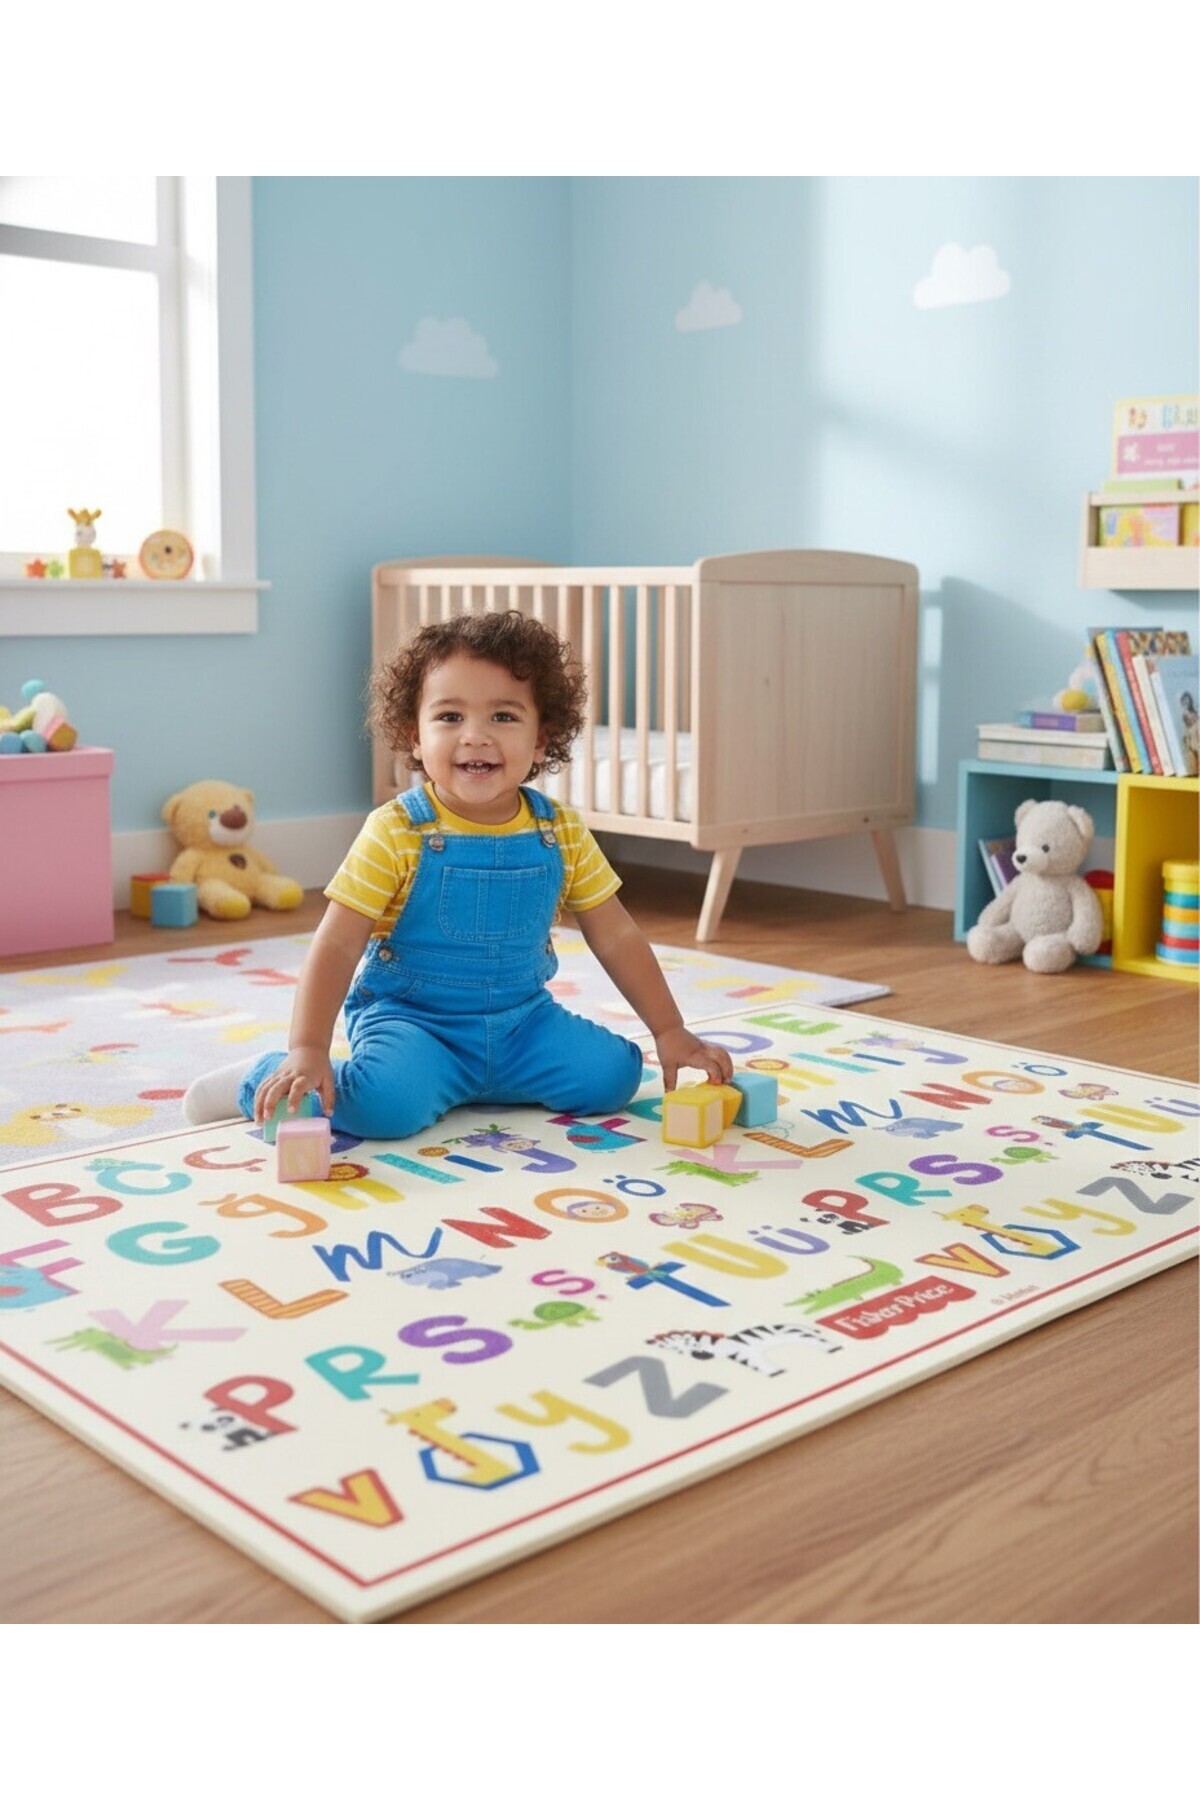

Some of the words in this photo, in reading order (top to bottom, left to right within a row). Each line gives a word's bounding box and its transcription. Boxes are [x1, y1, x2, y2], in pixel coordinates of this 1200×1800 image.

[742, 1131, 855, 1158] L
[899, 1082, 993, 1110] N
[1, 1182, 123, 1227] B
[95, 1162, 192, 1196] C
[801, 1188, 890, 1228] P
[855, 1171, 952, 1206] R
[908, 1154, 1004, 1186] S
[87, 1299, 248, 1350] K
[218, 1278, 349, 1319] L
[441, 1206, 552, 1249] N
[533, 1188, 629, 1223] O
[602, 1174, 667, 1197] Ö
[105, 1221, 221, 1266] G
[203, 1375, 298, 1434] P
[304, 1345, 420, 1401] R
[397, 1315, 513, 1364] S
